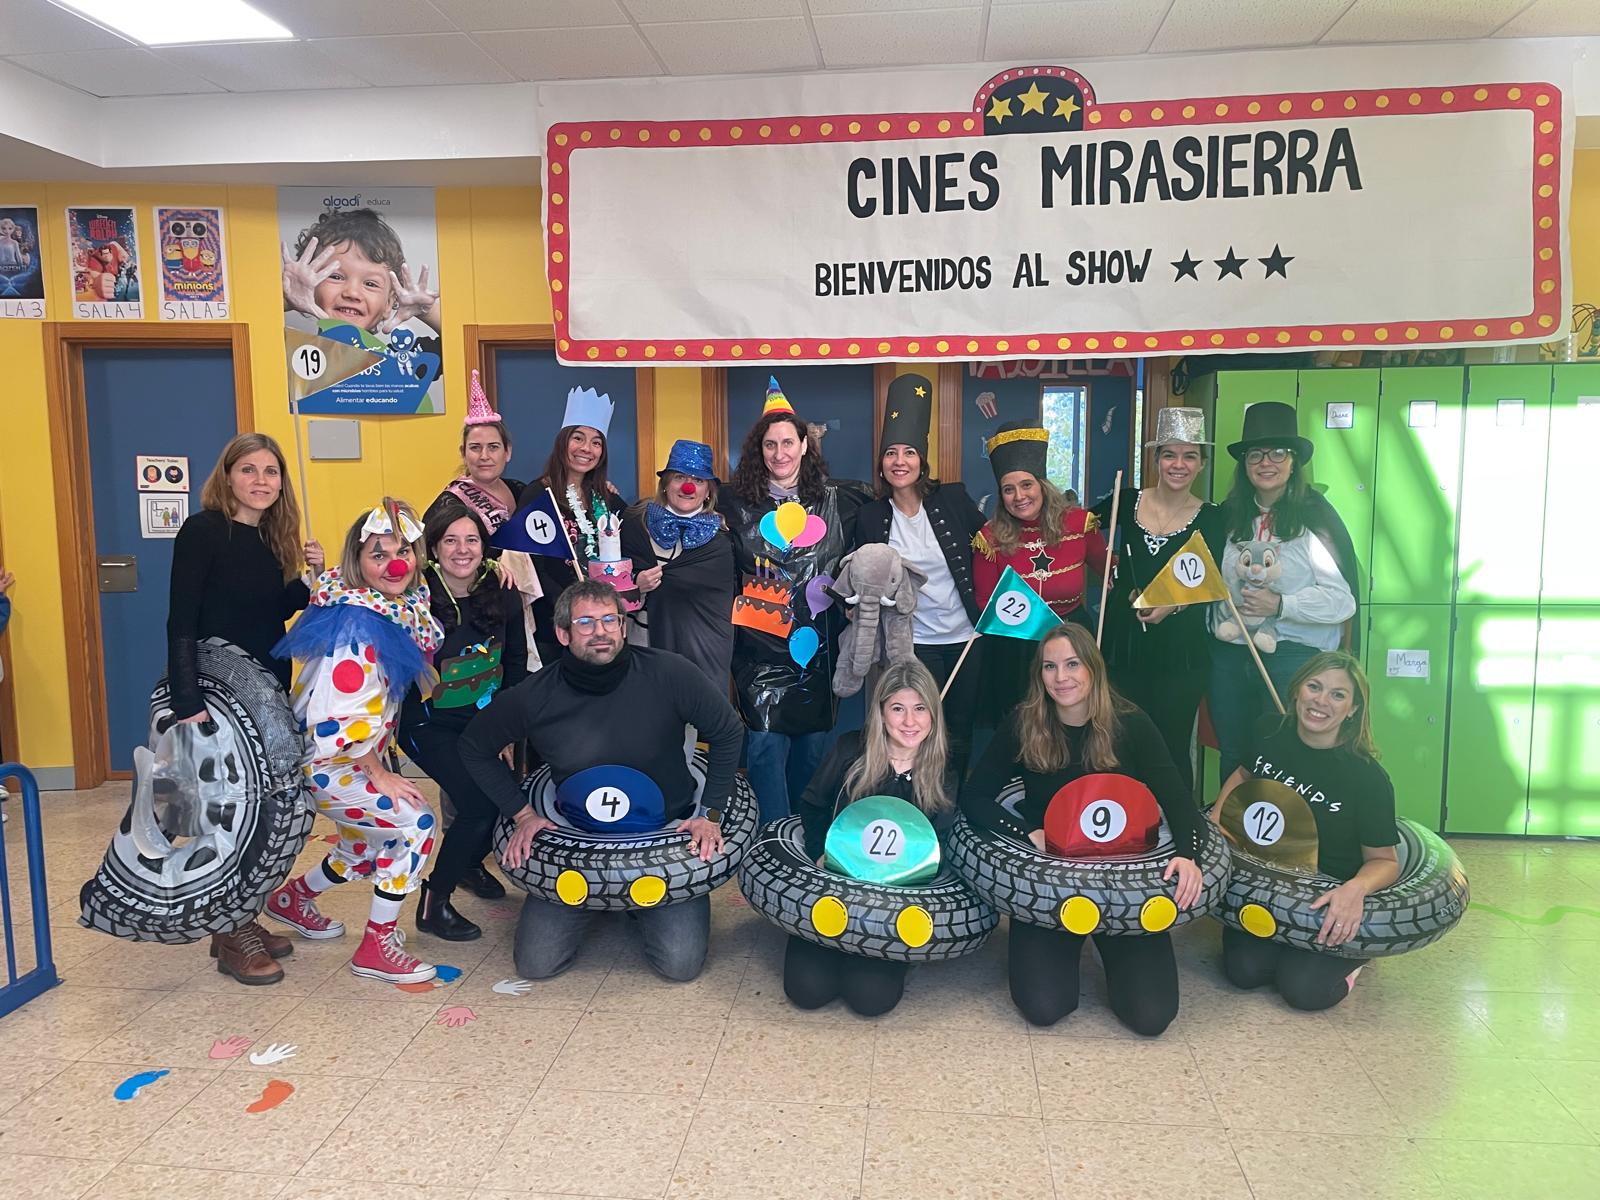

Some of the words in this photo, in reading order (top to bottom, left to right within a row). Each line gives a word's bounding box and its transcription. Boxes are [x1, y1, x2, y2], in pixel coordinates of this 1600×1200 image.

[846, 150, 999, 218] CINES
[1041, 127, 1362, 208] MIRASIERRA
[367, 198, 391, 206] educa
[815, 254, 992, 297] BIENVENIDOS
[1012, 253, 1049, 288] AL
[1065, 248, 1152, 286] SHOW
[31, 301, 43, 317] 3
[78, 303, 125, 319] SALA
[129, 303, 142, 319] 4
[164, 302, 213, 320] SALA
[217, 302, 228, 318] 5
[300, 349, 320, 376] 19
[459, 482, 502, 526] CUMPLE
[533, 518, 548, 538] 4
[1180, 557, 1202, 582] 12
[1001, 597, 1026, 618] 22
[601, 791, 621, 818] 4
[1092, 806, 1111, 838] 9
[1252, 806, 1279, 842] 12
[539, 833, 692, 850] ERFORMANCE
[870, 825, 898, 856] 22
[98, 873, 185, 916] PERFOR
